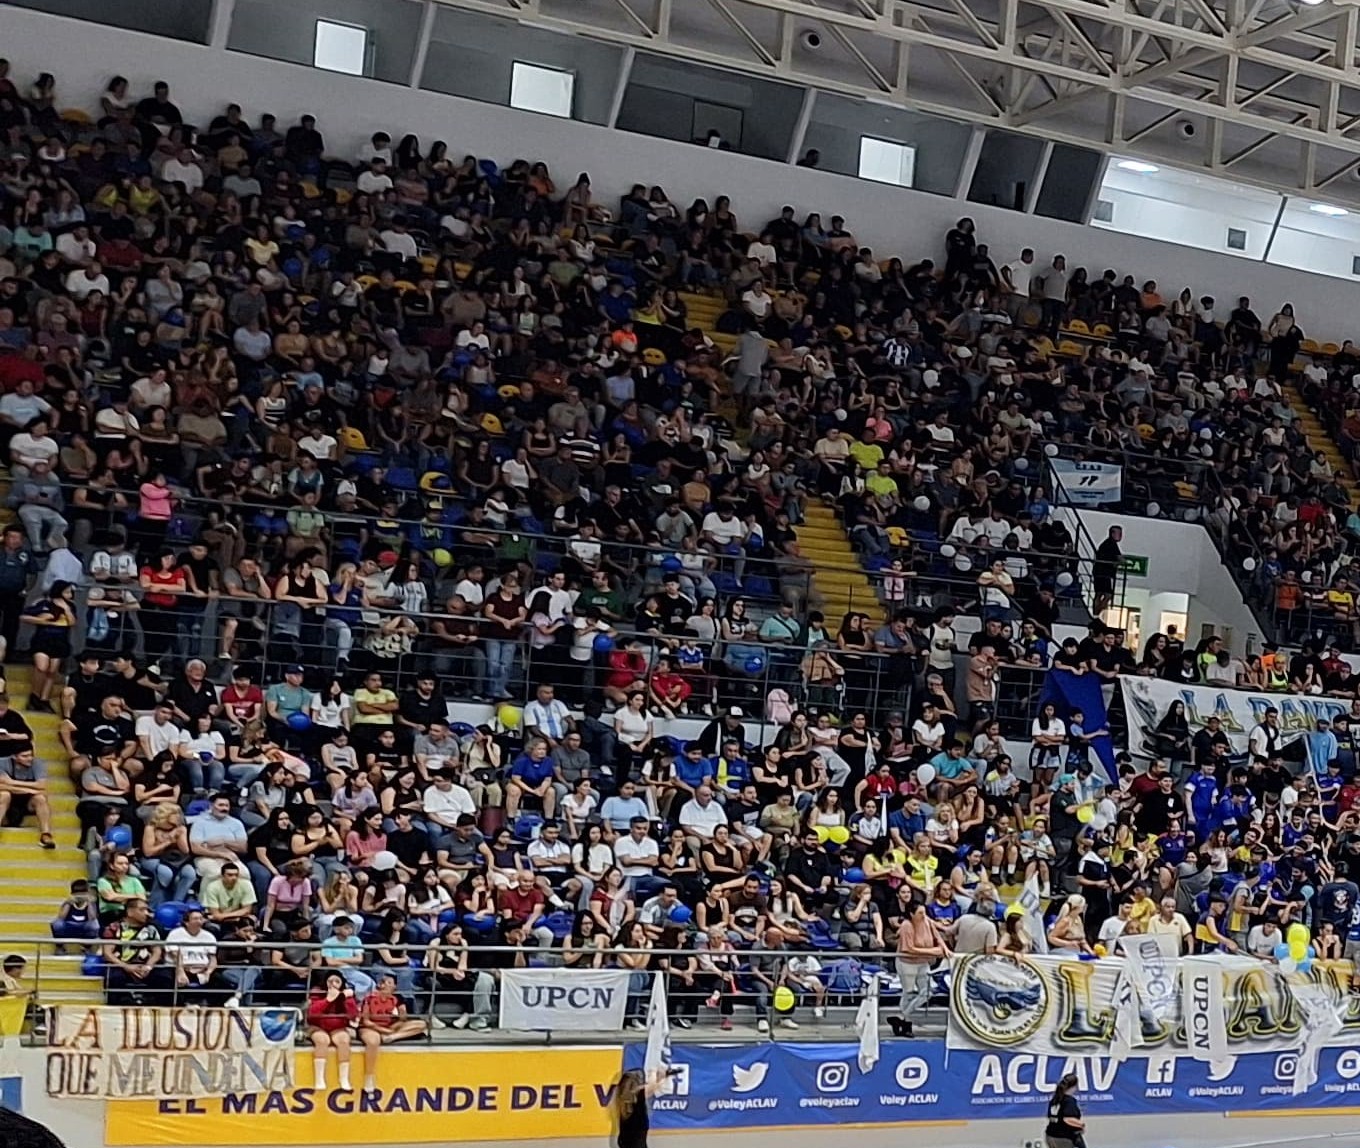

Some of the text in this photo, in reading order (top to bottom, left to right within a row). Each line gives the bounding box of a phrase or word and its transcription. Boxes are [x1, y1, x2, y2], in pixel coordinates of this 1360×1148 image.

[520, 986, 614, 1008] UPCN
[1193, 975, 1210, 1050] UPCN
[49, 1008, 257, 1050] LA ILUSION
[46, 1052, 101, 1097] QUE
[107, 1053, 159, 1096] ME
[970, 1054, 1120, 1095] ACLAV
[222, 1088, 314, 1114] MAS
[327, 1085, 499, 1113] GRANDE
[511, 1084, 581, 1110] DEL
[799, 1095, 860, 1108] @voleyaclav
[880, 1093, 938, 1107] Voley ACLAV
[1146, 1088, 1172, 1097] ACLAV
[653, 1101, 687, 1111] ACLAV
[708, 1097, 778, 1111] @VoleyACLAV
